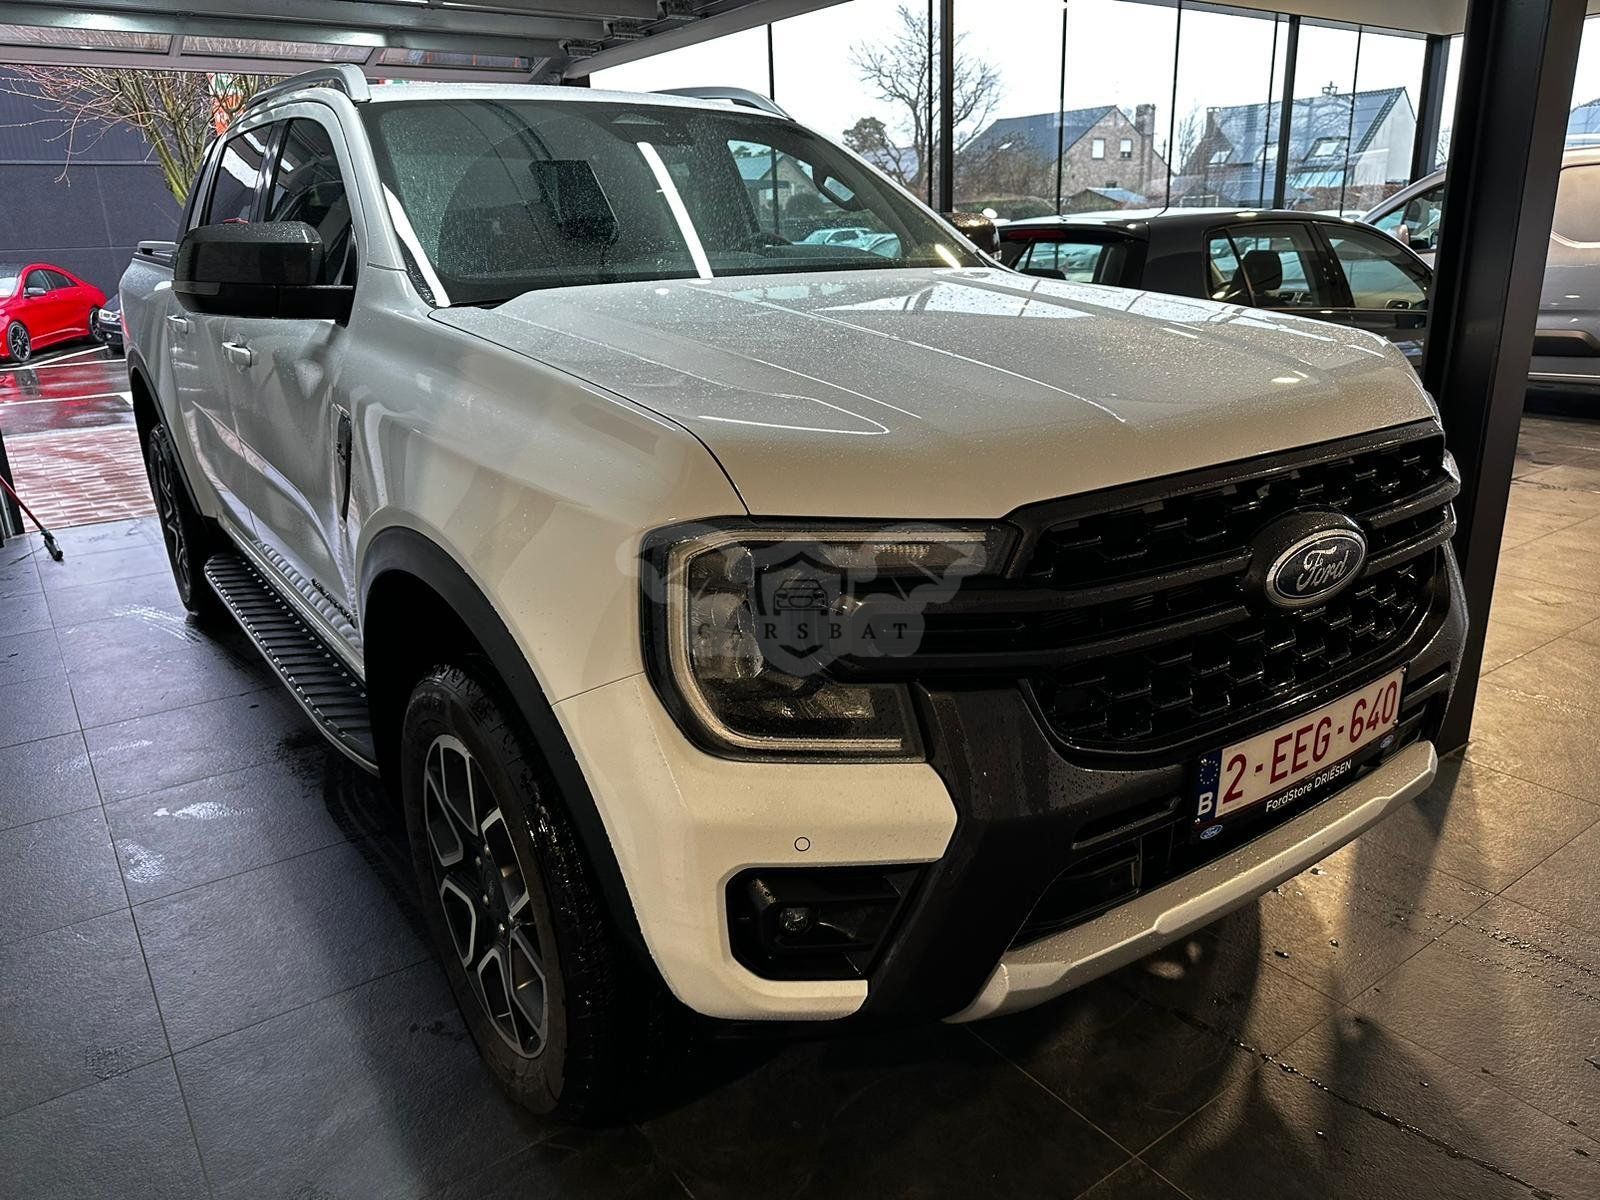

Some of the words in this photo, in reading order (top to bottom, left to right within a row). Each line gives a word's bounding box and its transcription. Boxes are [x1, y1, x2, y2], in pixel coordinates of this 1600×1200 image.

[1296, 545, 1349, 592] Ford
[1222, 681, 1397, 804] 2-EEG-640
[1197, 792, 1212, 816] B
[1265, 782, 1313, 813] FordStore
[1314, 760, 1352, 788] DRIESEN
